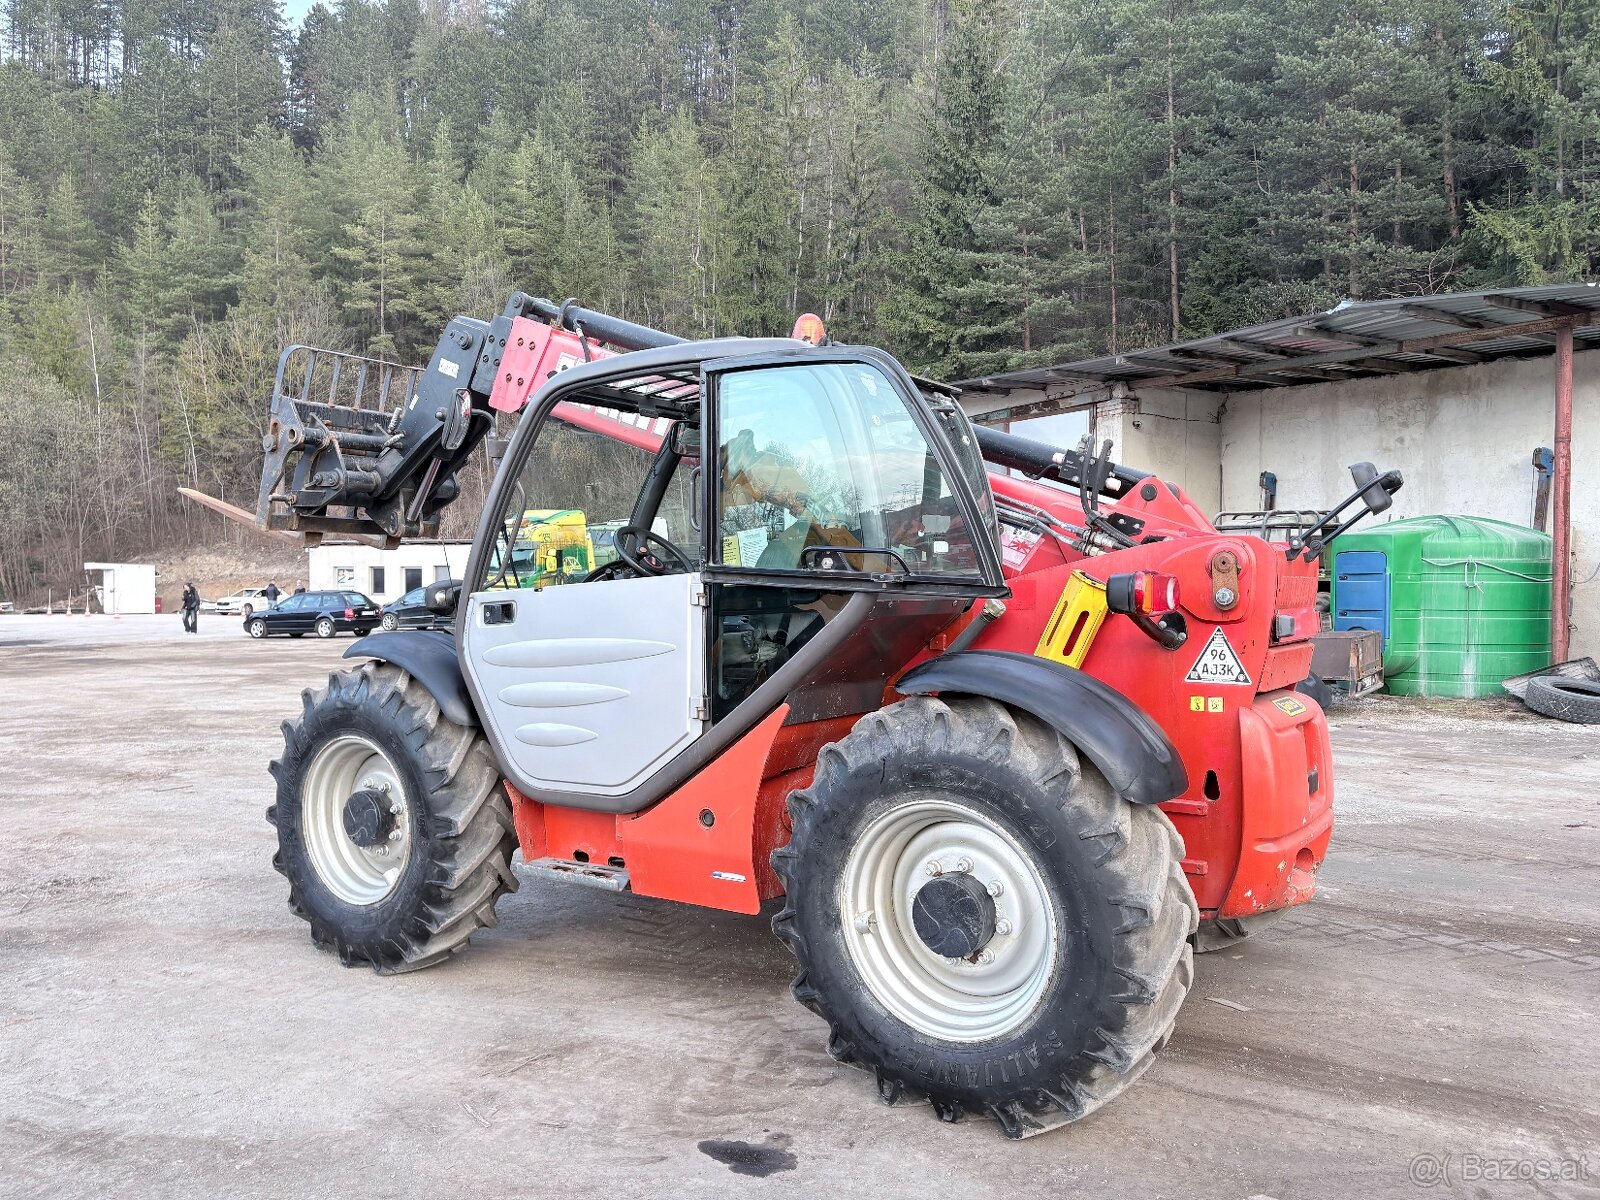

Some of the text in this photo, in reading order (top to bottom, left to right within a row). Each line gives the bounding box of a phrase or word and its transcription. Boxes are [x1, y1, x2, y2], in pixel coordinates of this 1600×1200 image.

[1210, 648, 1226, 661] 96
[1201, 663, 1235, 676] AJ3K
[896, 1041, 1041, 1088] ALLIANCE
